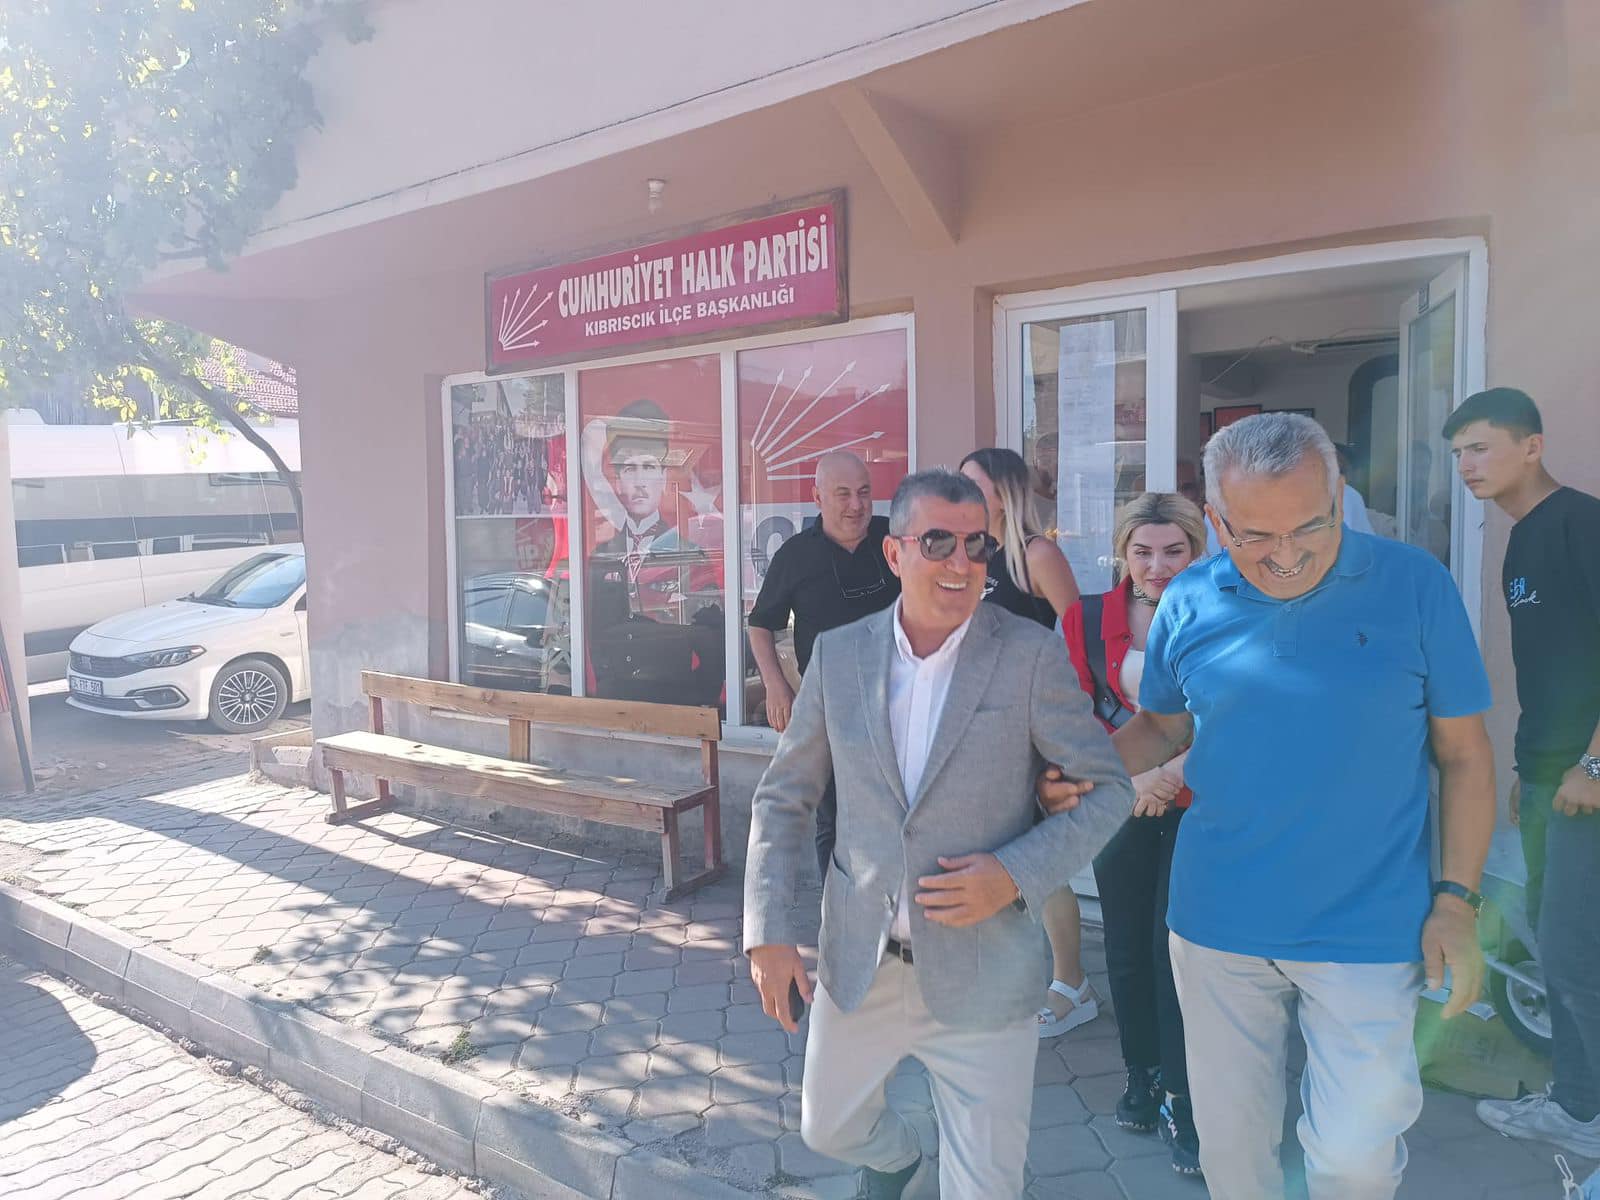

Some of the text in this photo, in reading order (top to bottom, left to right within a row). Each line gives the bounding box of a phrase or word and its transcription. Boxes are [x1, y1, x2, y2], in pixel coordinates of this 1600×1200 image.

[558, 214, 829, 318] CUMHURİYET HALK PARTİSİ
[585, 283, 795, 337] KIBRISCIK İLÇE BAŞKANLIĞI
